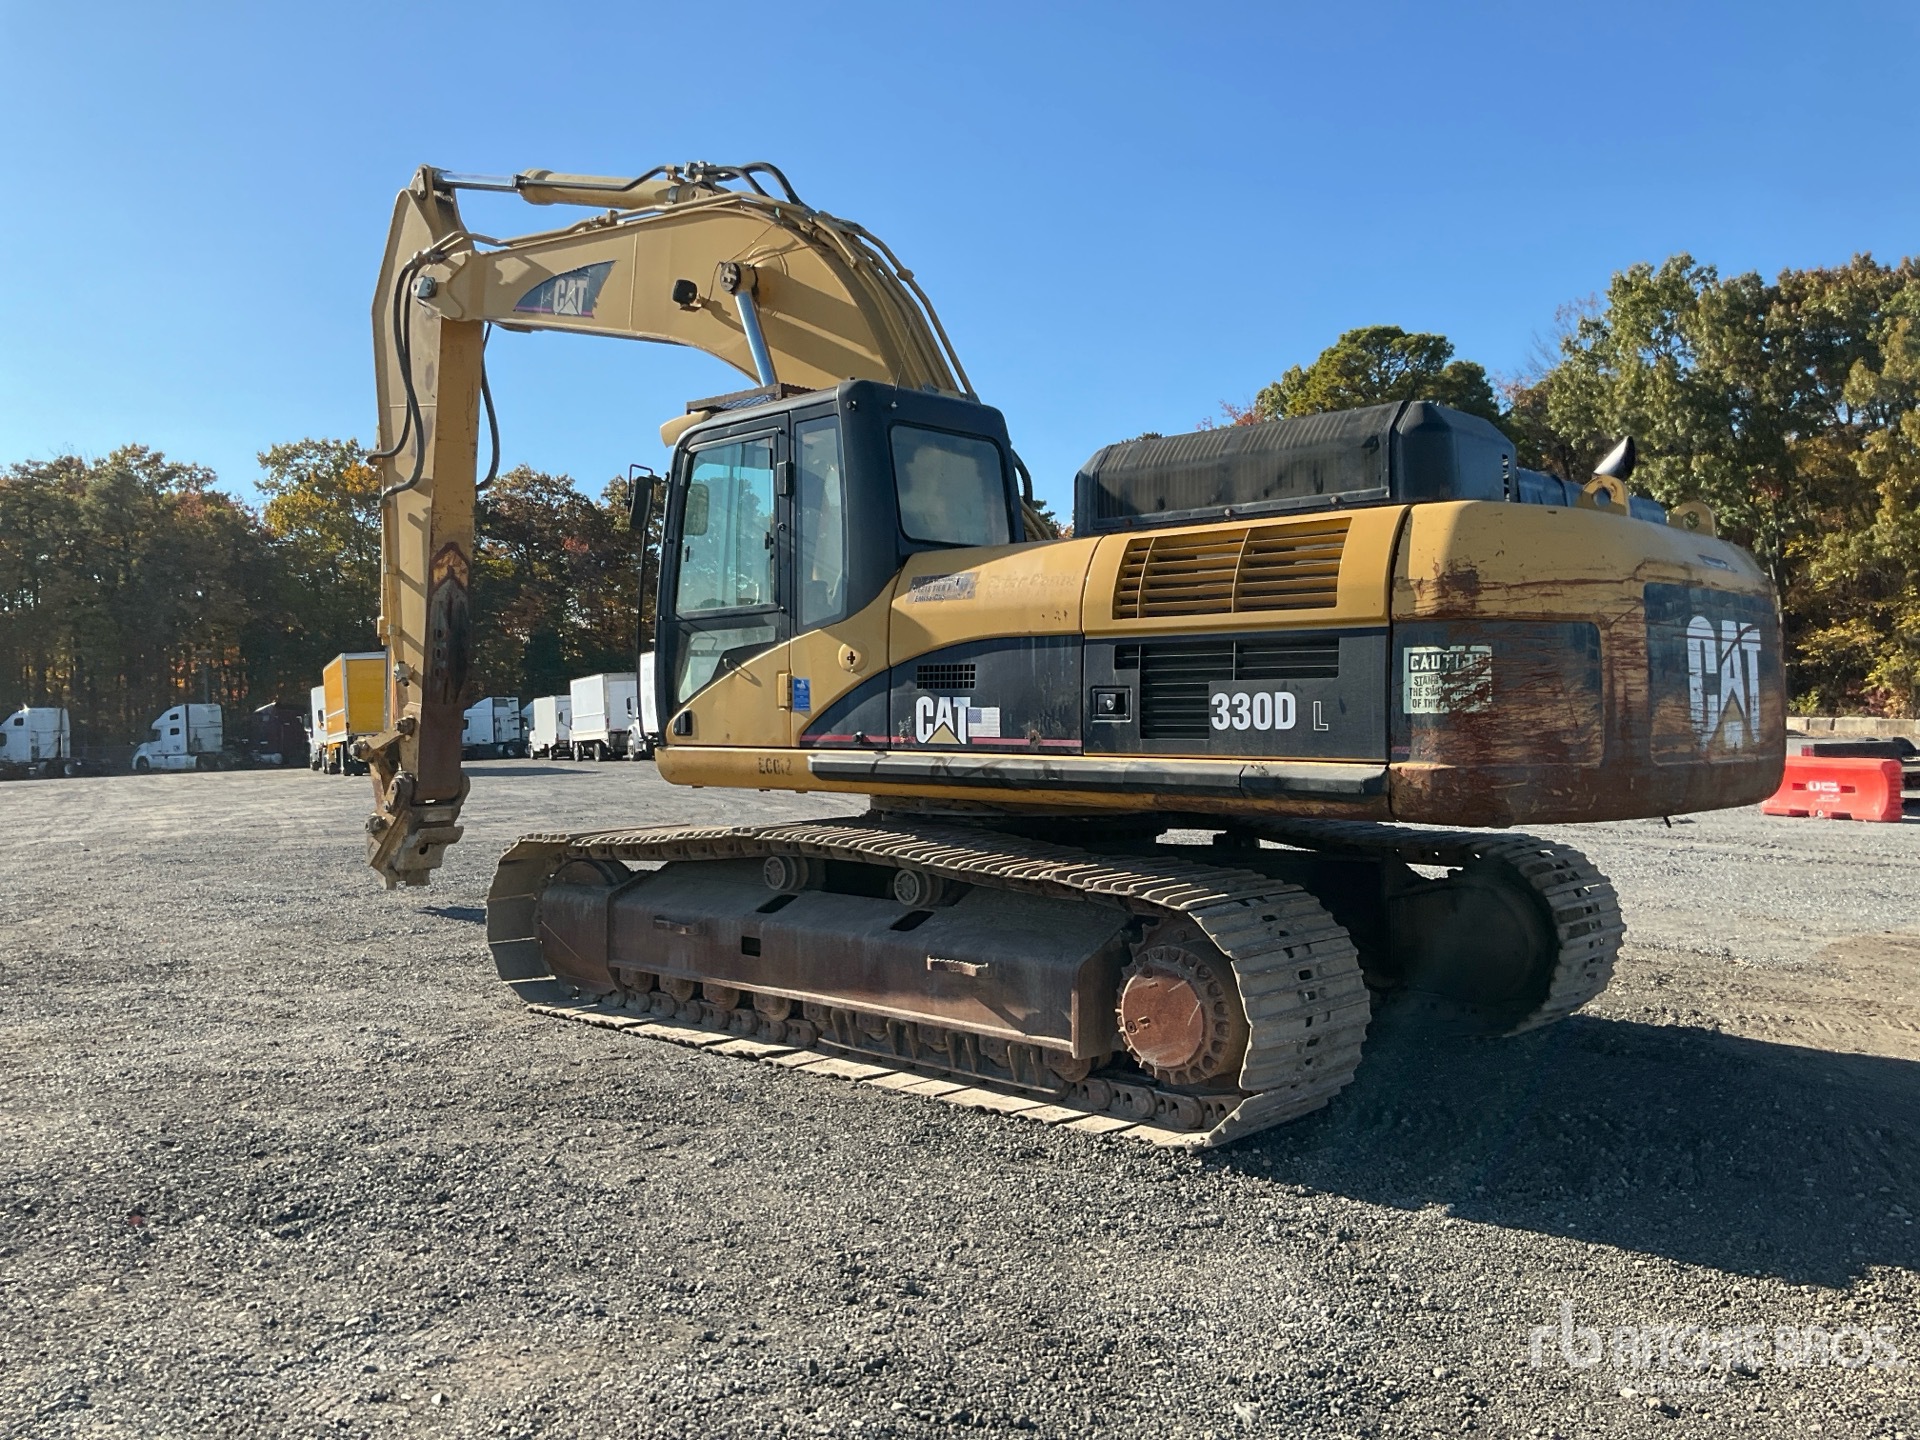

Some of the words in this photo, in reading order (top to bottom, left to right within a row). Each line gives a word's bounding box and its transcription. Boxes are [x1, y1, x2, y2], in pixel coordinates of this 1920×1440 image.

[553, 279, 588, 315] CAT
[1409, 687, 1423, 697] THE
[1686, 615, 1762, 751] CAT
[916, 695, 971, 745] CAT
[1211, 691, 1297, 731] 330D
[1313, 701, 1329, 731] L
[1412, 699, 1421, 709] OF
